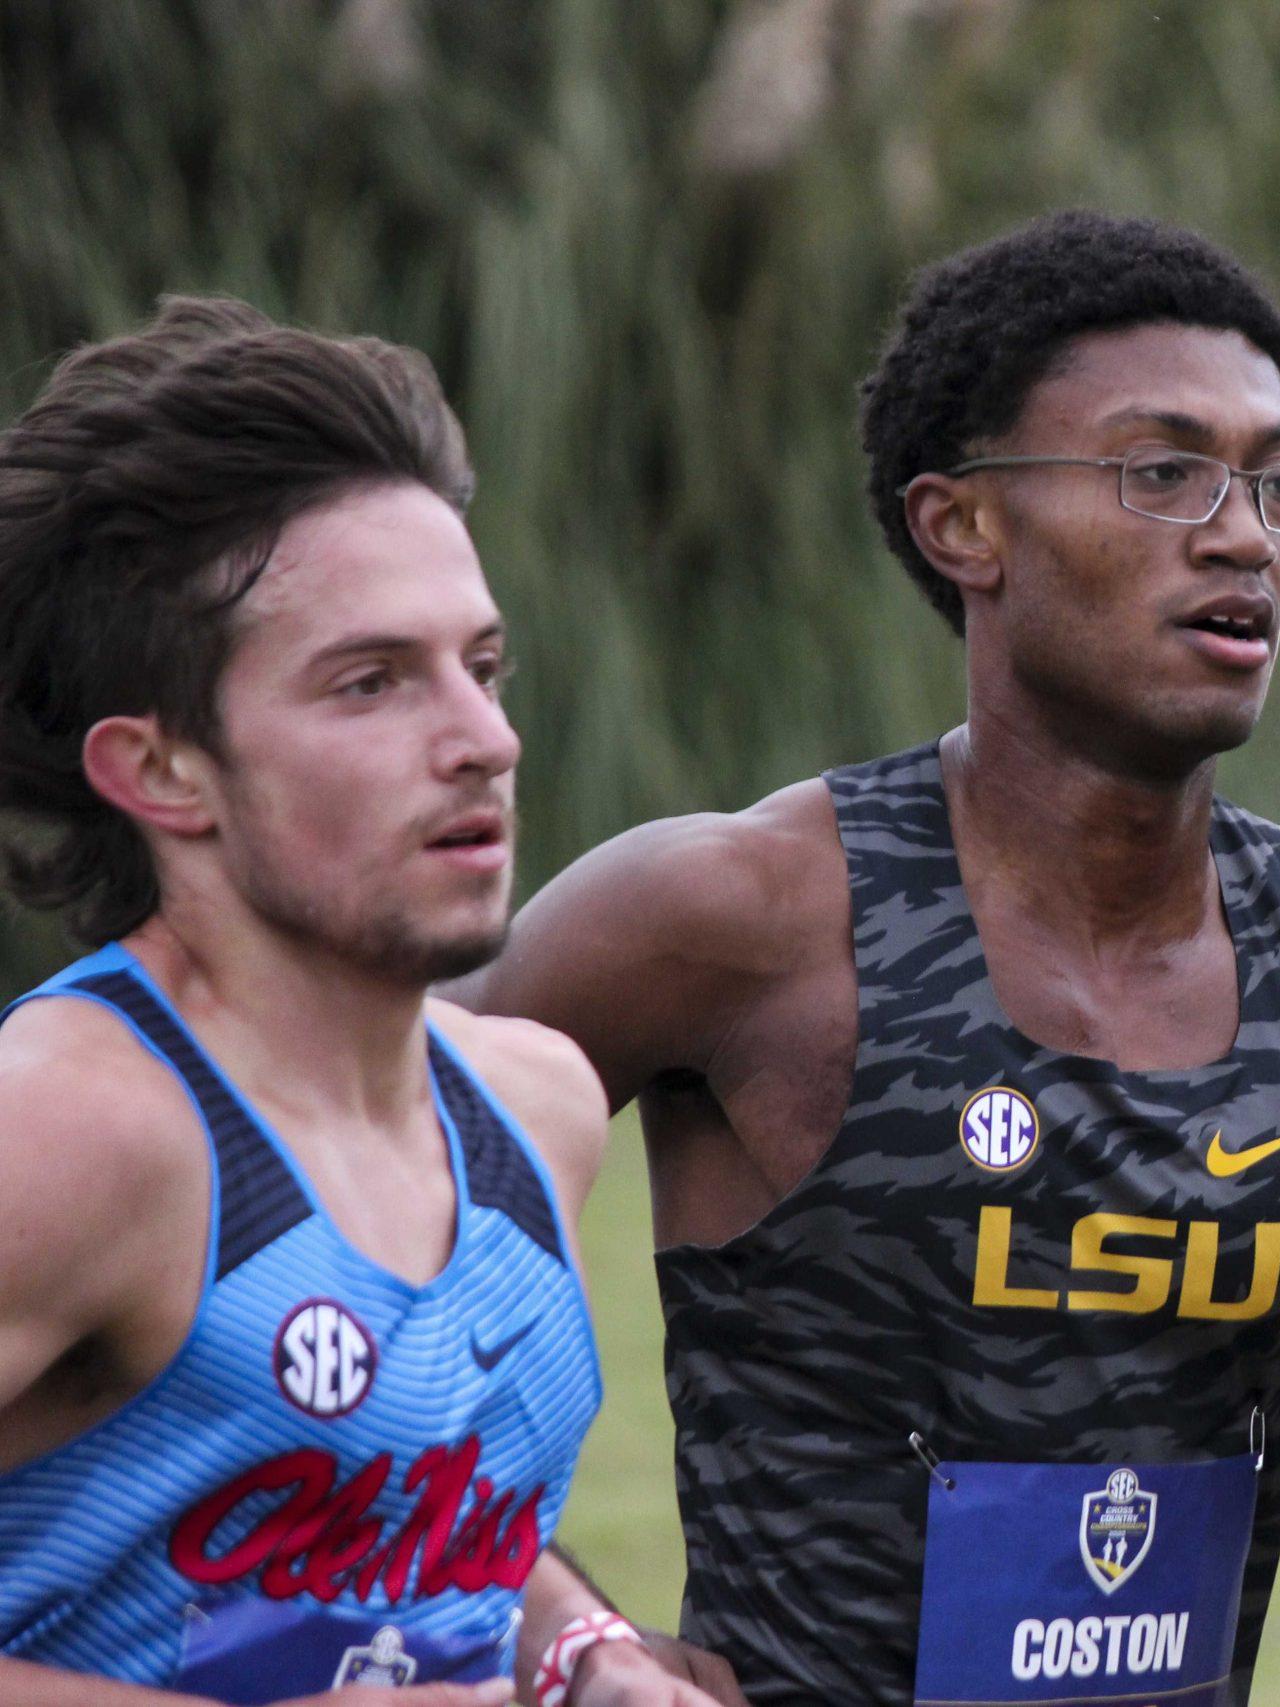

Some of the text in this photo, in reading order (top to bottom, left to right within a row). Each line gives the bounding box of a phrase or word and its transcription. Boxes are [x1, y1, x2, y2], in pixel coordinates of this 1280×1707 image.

[964, 1091, 1033, 1167] SEC
[281, 1303, 370, 1415] SEC
[1100, 1513, 1139, 1523] COUNTRY
[1105, 1506, 1134, 1514] CROSS
[1110, 1472, 1137, 1500] SEC
[169, 1446, 393, 1602] Ole
[1012, 1612, 1189, 1681] COSTON
